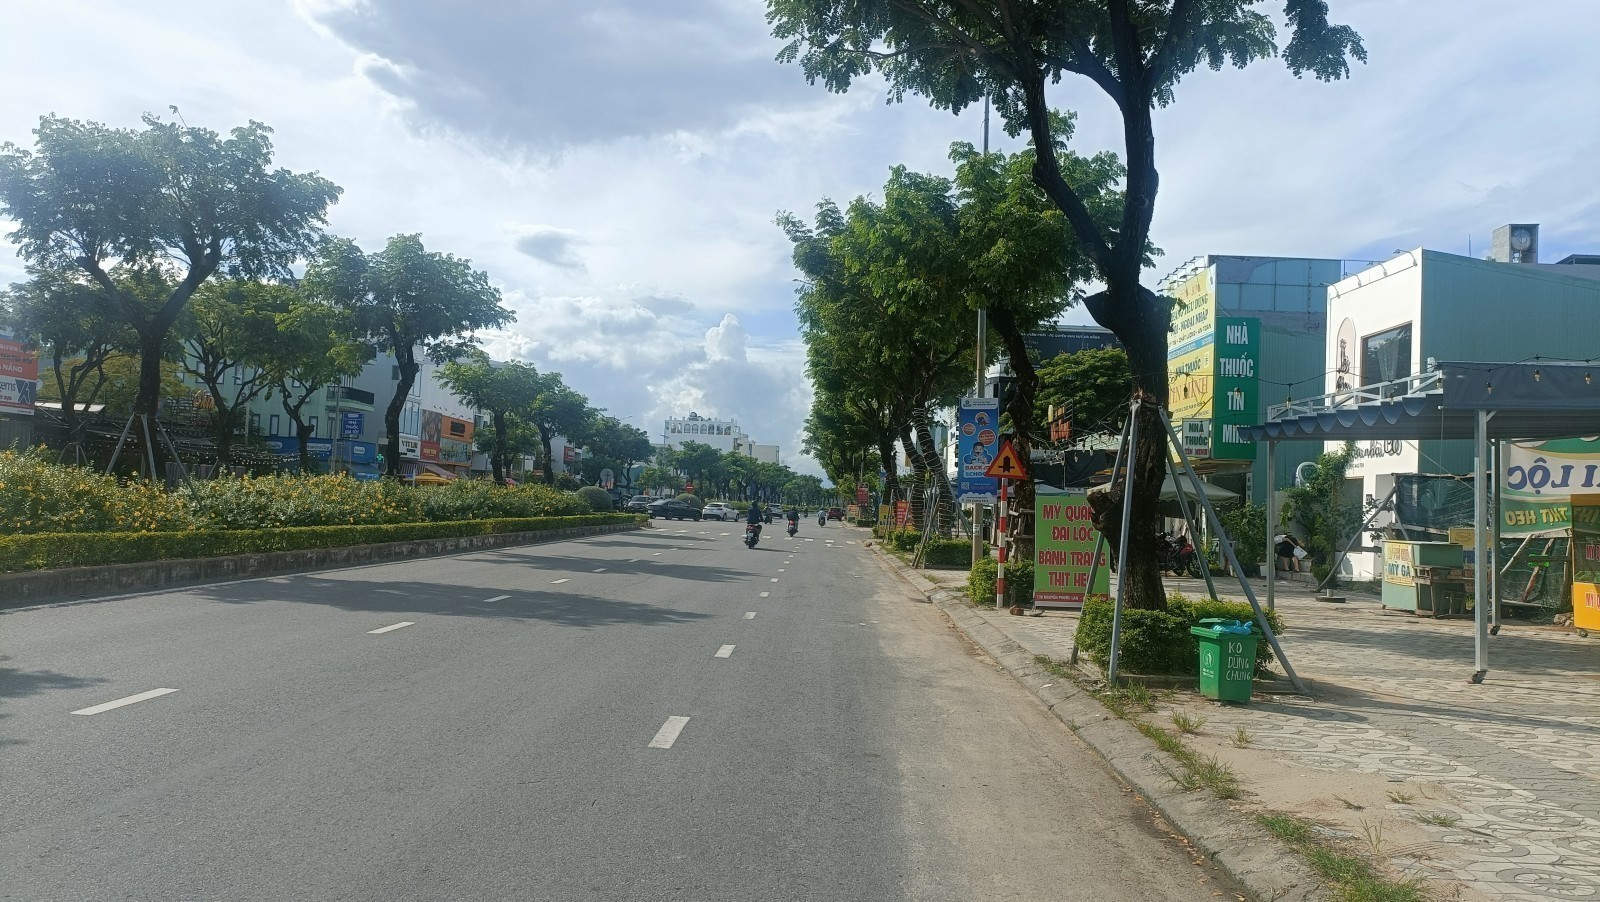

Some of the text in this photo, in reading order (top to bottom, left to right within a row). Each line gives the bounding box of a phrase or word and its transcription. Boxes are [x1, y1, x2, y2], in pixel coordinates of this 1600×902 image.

[1226, 321, 1249, 345] NHÀ
[1185, 356, 1201, 373] THUỐC
[1219, 352, 1254, 378] THUỐC
[0, 381, 16, 391] ems
[1227, 386, 1245, 411] TÍN
[1188, 421, 1204, 433] NHÀ
[1222, 424, 1251, 444] MIN
[1184, 433, 1208, 446] THUỐC
[1065, 502, 1094, 523] QUẢN
[1052, 523, 1095, 545] ĐẠI LỘC
[1038, 548, 1067, 566] BÁNH
[1388, 561, 1411, 578] MỲ GÀ
[1048, 571, 1071, 590] THỊT
[1228, 641, 1243, 654] KO
[1225, 670, 1251, 681] CHUNG
